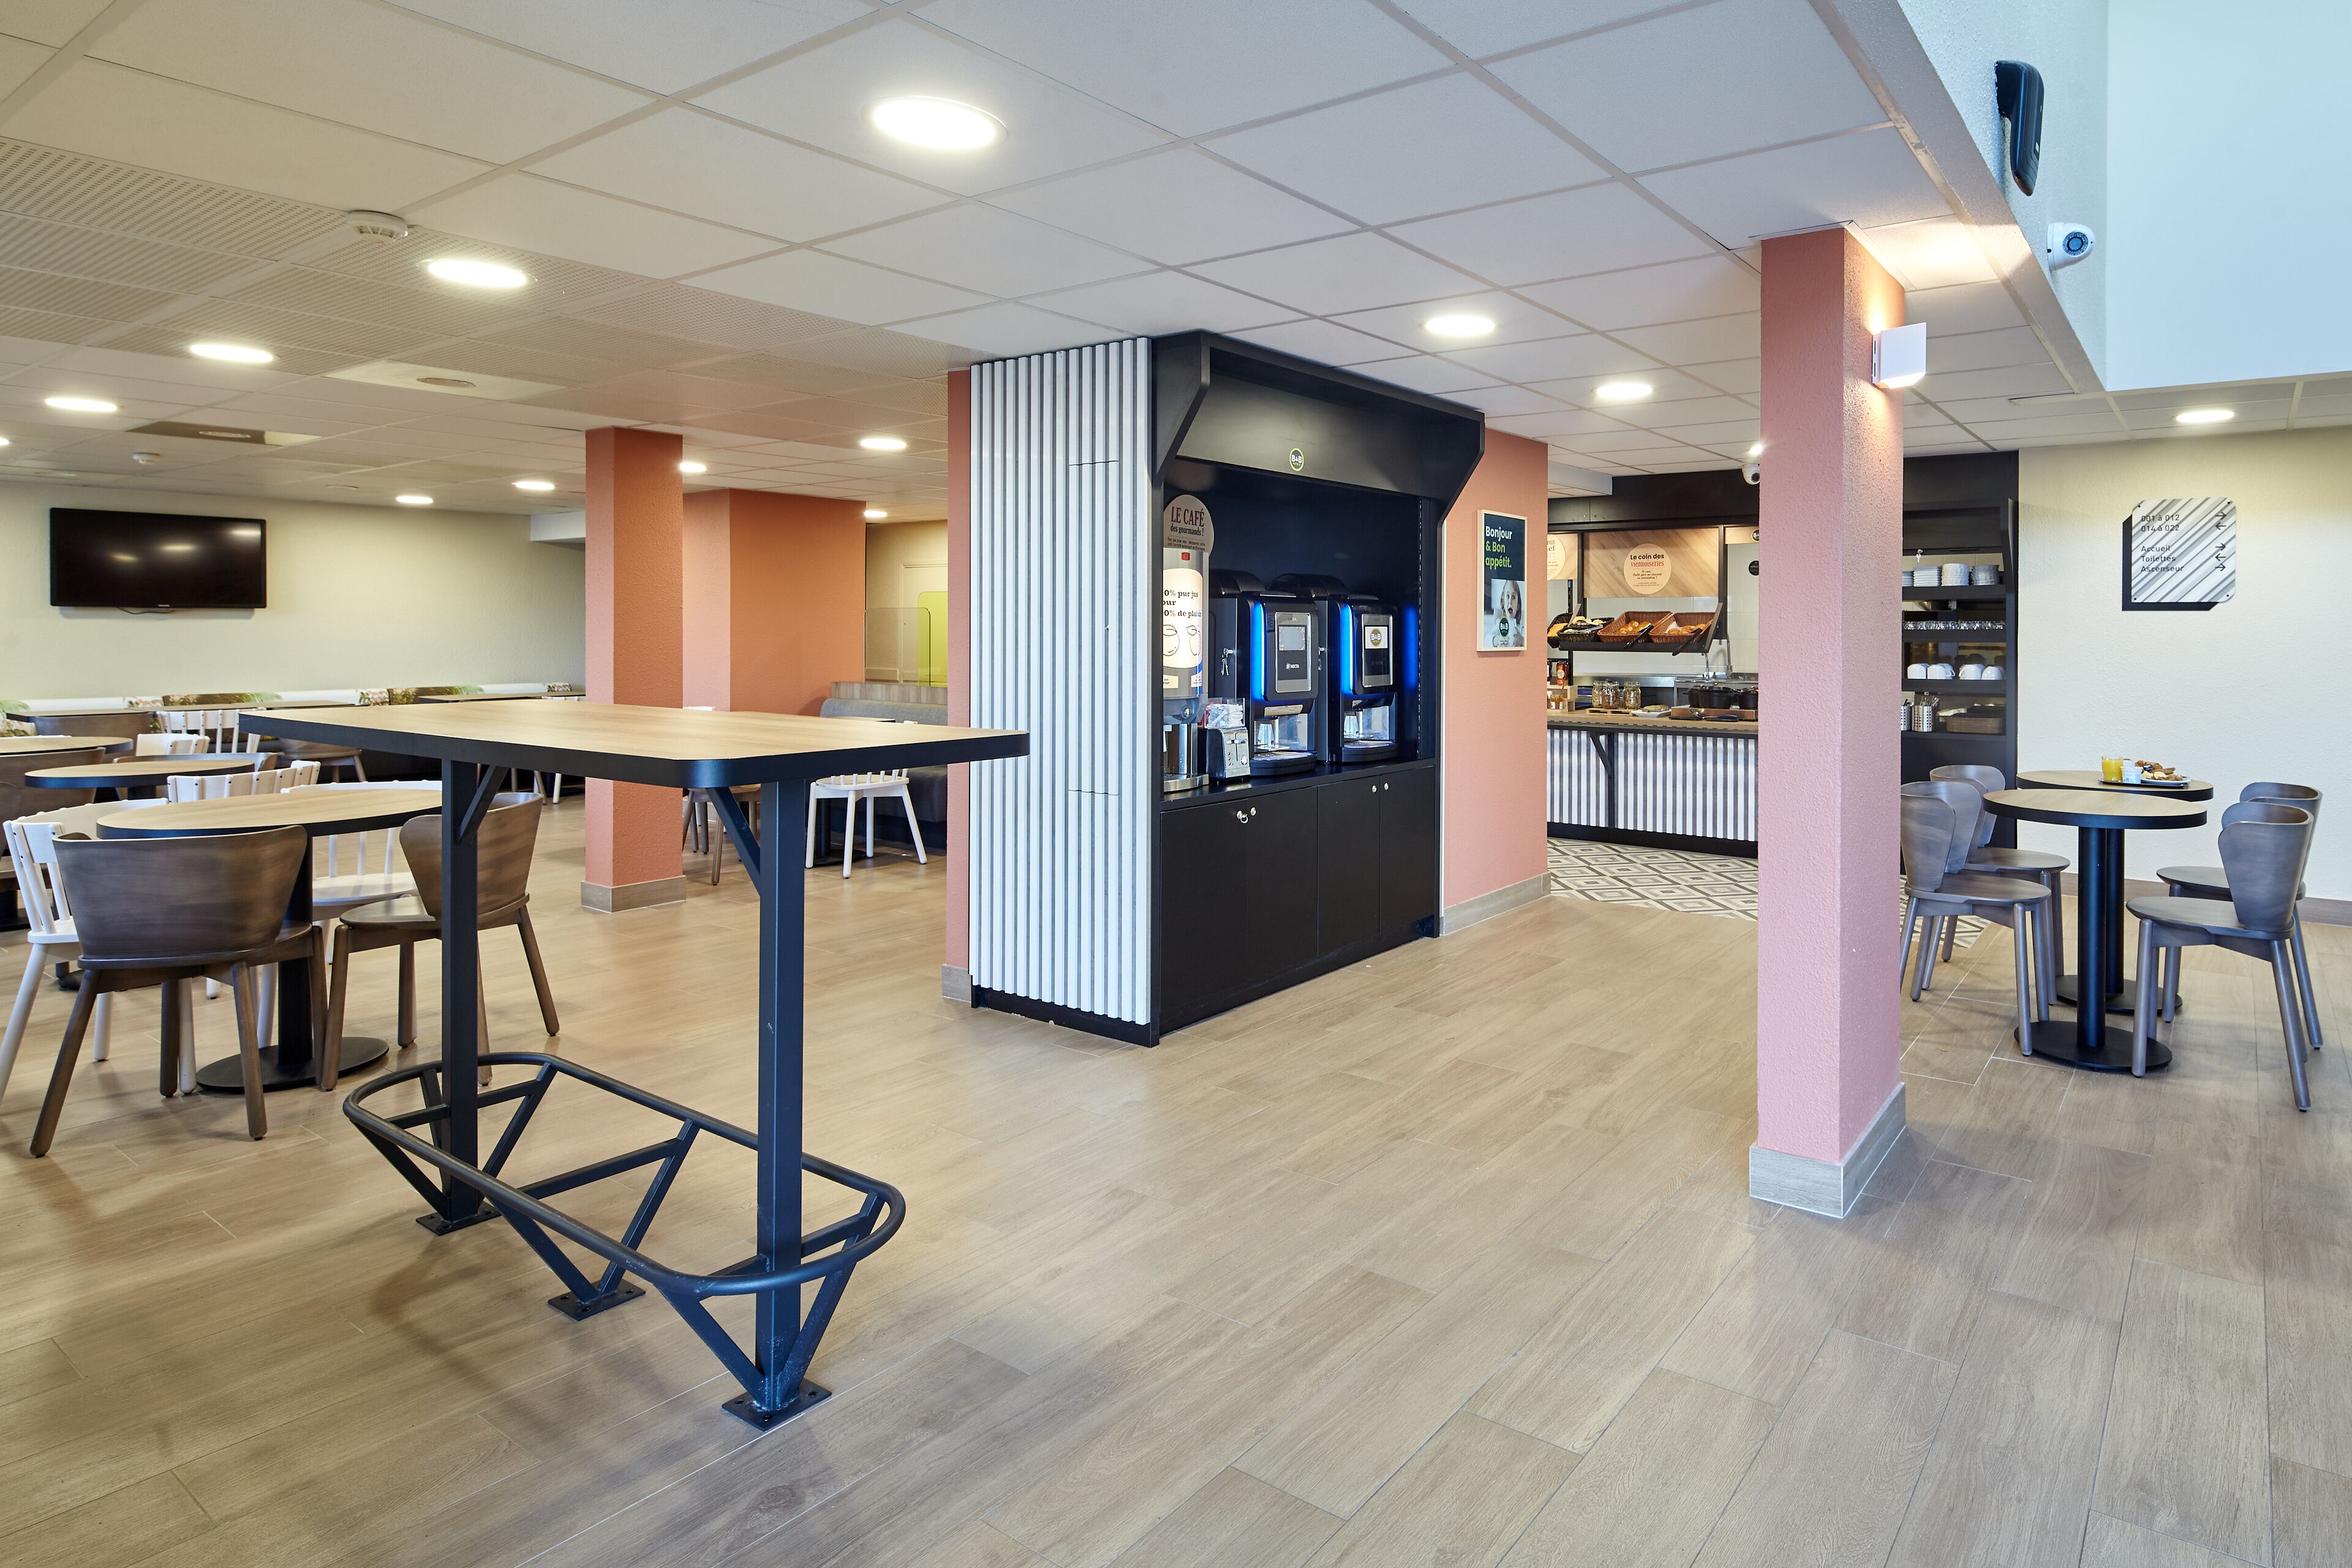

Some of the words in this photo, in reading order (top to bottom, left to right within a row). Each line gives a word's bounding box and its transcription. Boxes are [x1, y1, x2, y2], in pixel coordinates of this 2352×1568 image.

[1291, 454, 1302, 464] B&B
[1171, 507, 1182, 523] LE
[1183, 508, 1204, 527] CAFÉ
[1179, 527, 1201, 536] gourmands
[1485, 526, 1513, 542] Bonjour
[1485, 540, 1491, 551] &
[1492, 541, 1506, 553] Bon
[1485, 555, 1512, 570] appétit.
